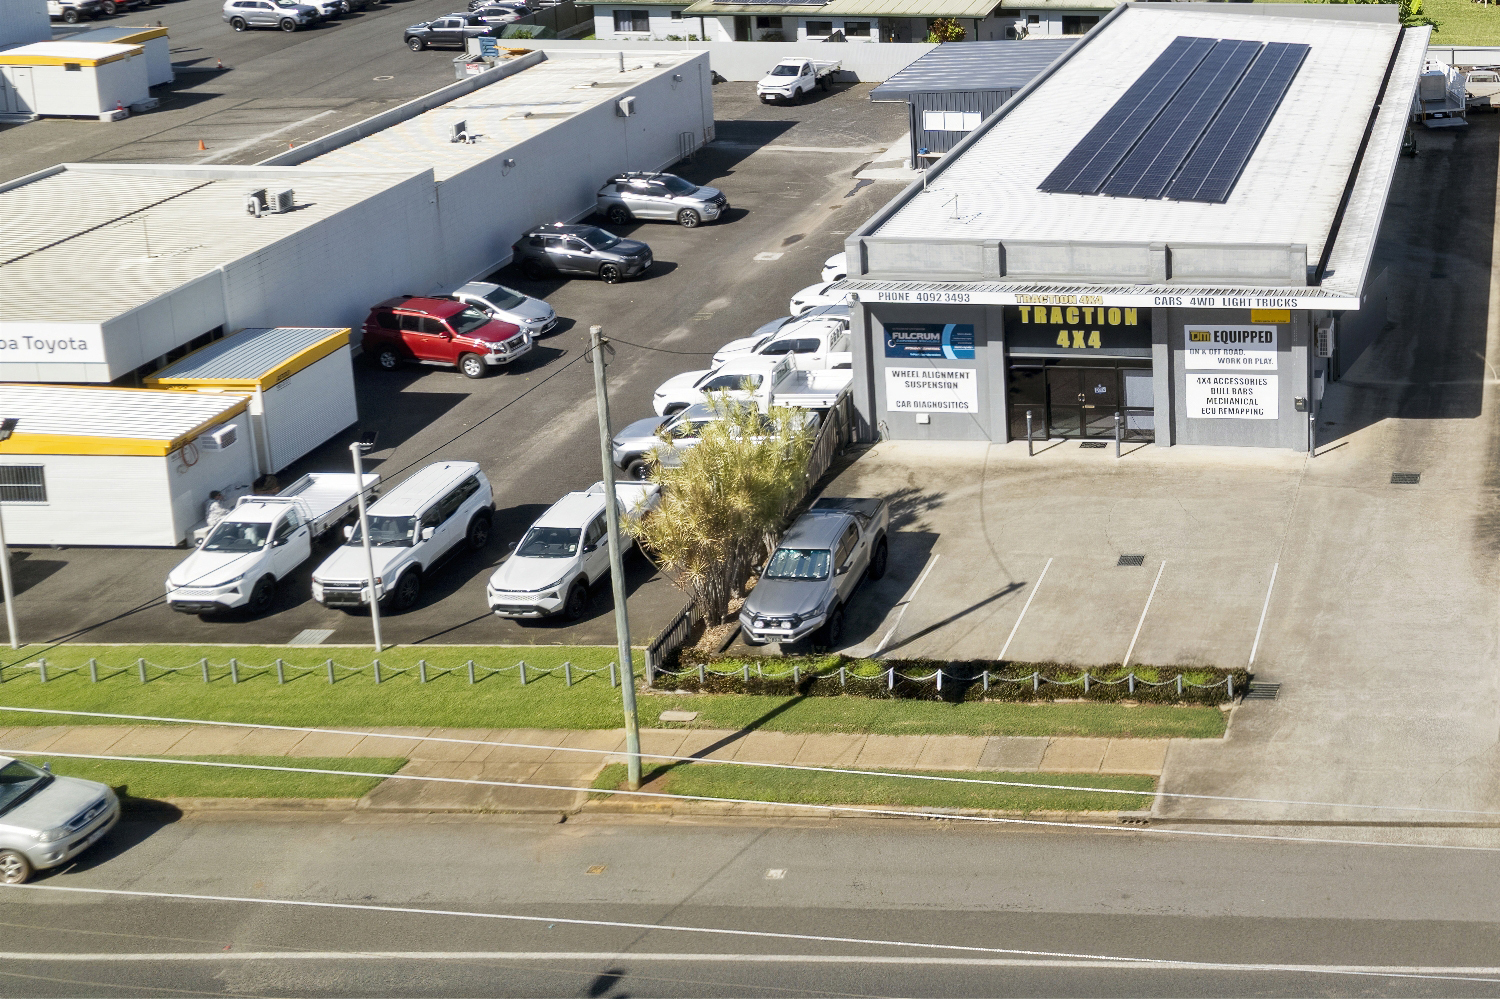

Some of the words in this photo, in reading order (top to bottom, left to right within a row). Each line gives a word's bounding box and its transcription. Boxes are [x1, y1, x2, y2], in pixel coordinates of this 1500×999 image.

[878, 292, 910, 301] PHONE
[916, 292, 942, 302] 4092
[944, 292, 970, 302] 3493
[1015, 293, 1077, 304] TRACTION
[1079, 295, 1104, 305] 4X4
[1154, 296, 1182, 306] CARS
[1189, 297, 1215, 306] 4WD
[1222, 297, 1252, 307] LIGHT
[1254, 298, 1298, 307] TRUCKS
[1019, 306, 1138, 326] TRACTION
[892, 332, 940, 340] FULCRUM
[1056, 330, 1102, 349] 4X4
[1213, 330, 1273, 344] EQUIPPED
[22, 335, 88, 354] Toyota
[1223, 348, 1246, 356] ROAD.
[1217, 357, 1241, 365] WORK
[1242, 357, 1253, 365] OR
[1254, 357, 1274, 365] PLAY.
[891, 370, 919, 378] WHEEL
[922, 371, 970, 379] ALIGNMENT
[904, 380, 958, 389] SUSPENSION
[1196, 377, 1211, 385] 4X4
[1213, 377, 1268, 386] ACCESSORIES
[1210, 387, 1230, 395] BULL
[1231, 387, 1254, 395] BARS
[895, 400, 912, 408] CAR
[1206, 397, 1259, 406] MECHANICAL
[1201, 407, 1216, 415] ECU
[1218, 407, 1264, 416] REMAPPING
